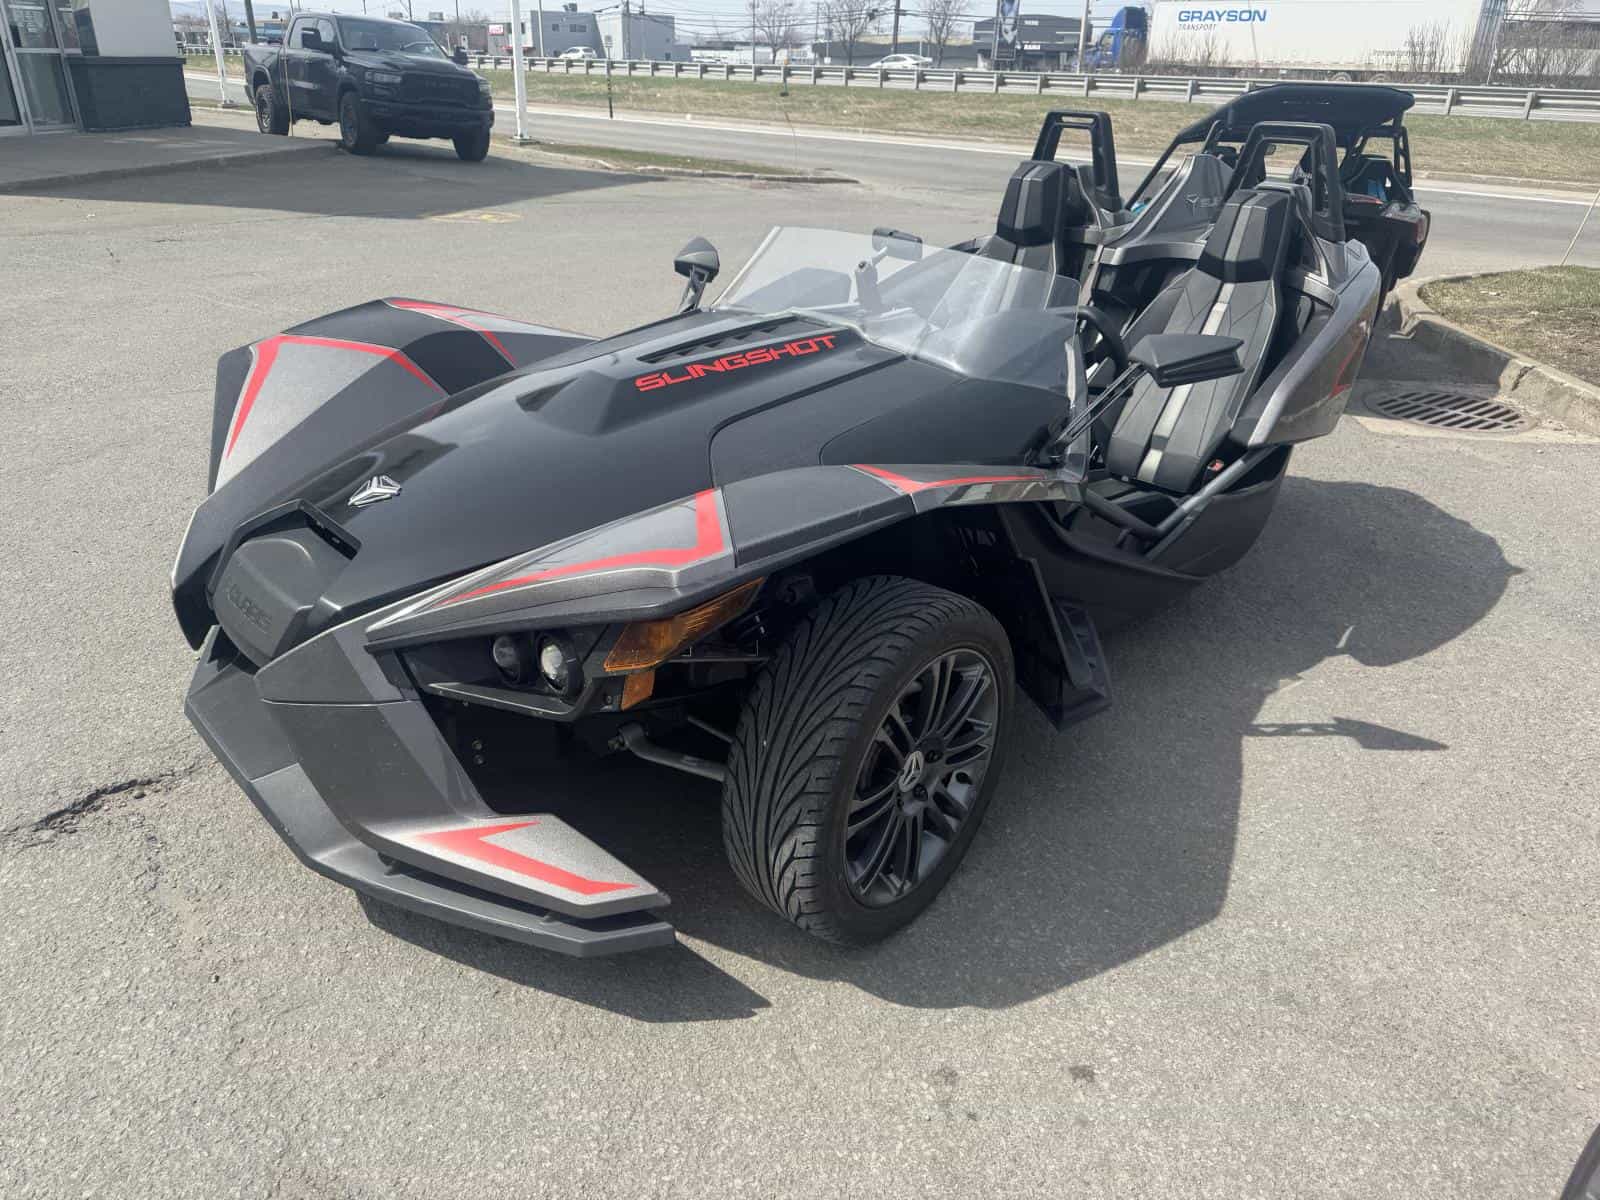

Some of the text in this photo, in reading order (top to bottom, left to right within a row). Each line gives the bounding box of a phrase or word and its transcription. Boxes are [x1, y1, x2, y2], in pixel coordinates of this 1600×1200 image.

[1178, 9, 1267, 22] GRAYSON
[1178, 23, 1217, 31] TRANSPORT
[634, 335, 836, 392] SLINGSHOT
